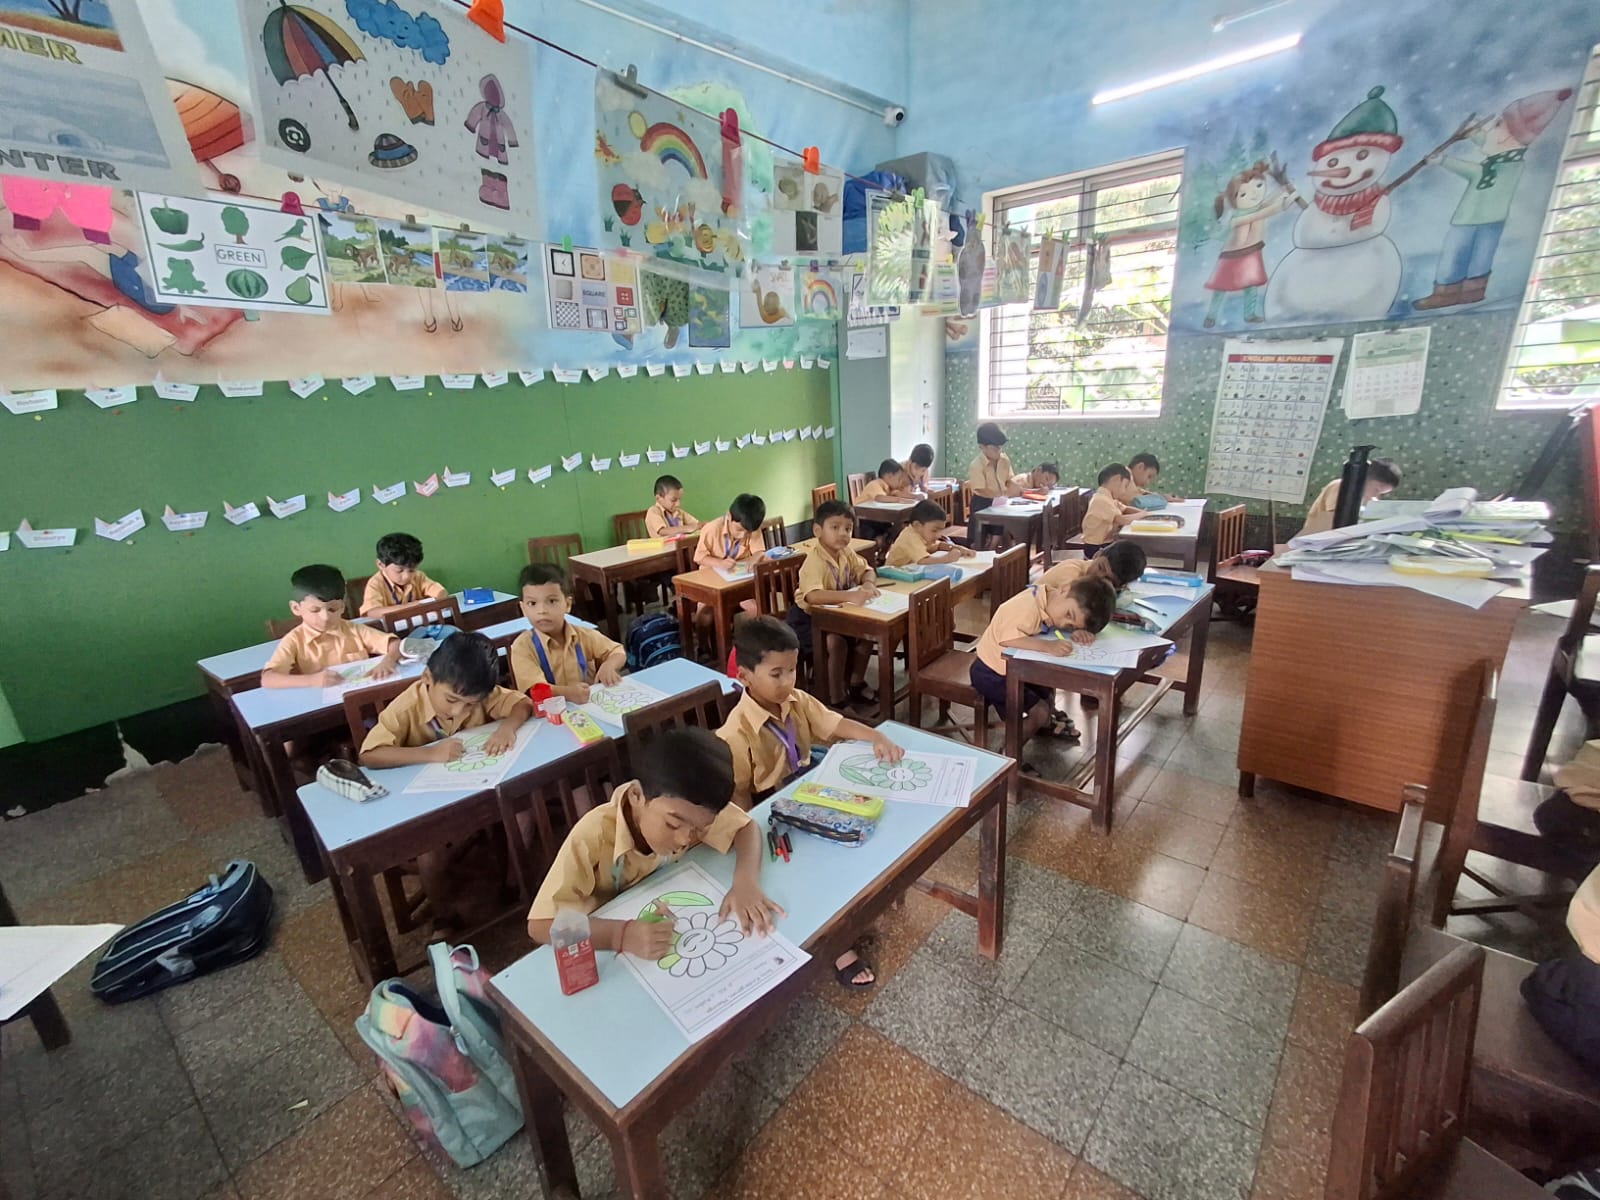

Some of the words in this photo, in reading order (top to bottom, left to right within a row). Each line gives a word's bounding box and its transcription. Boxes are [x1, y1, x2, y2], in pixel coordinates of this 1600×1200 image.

[0, 149, 121, 181] NTER
[216, 248, 261, 263] GREEN
[582, 289, 606, 298] SQUARE
[1242, 355, 1276, 363] ENGLISH
[1277, 355, 1317, 363] ALPHABET
